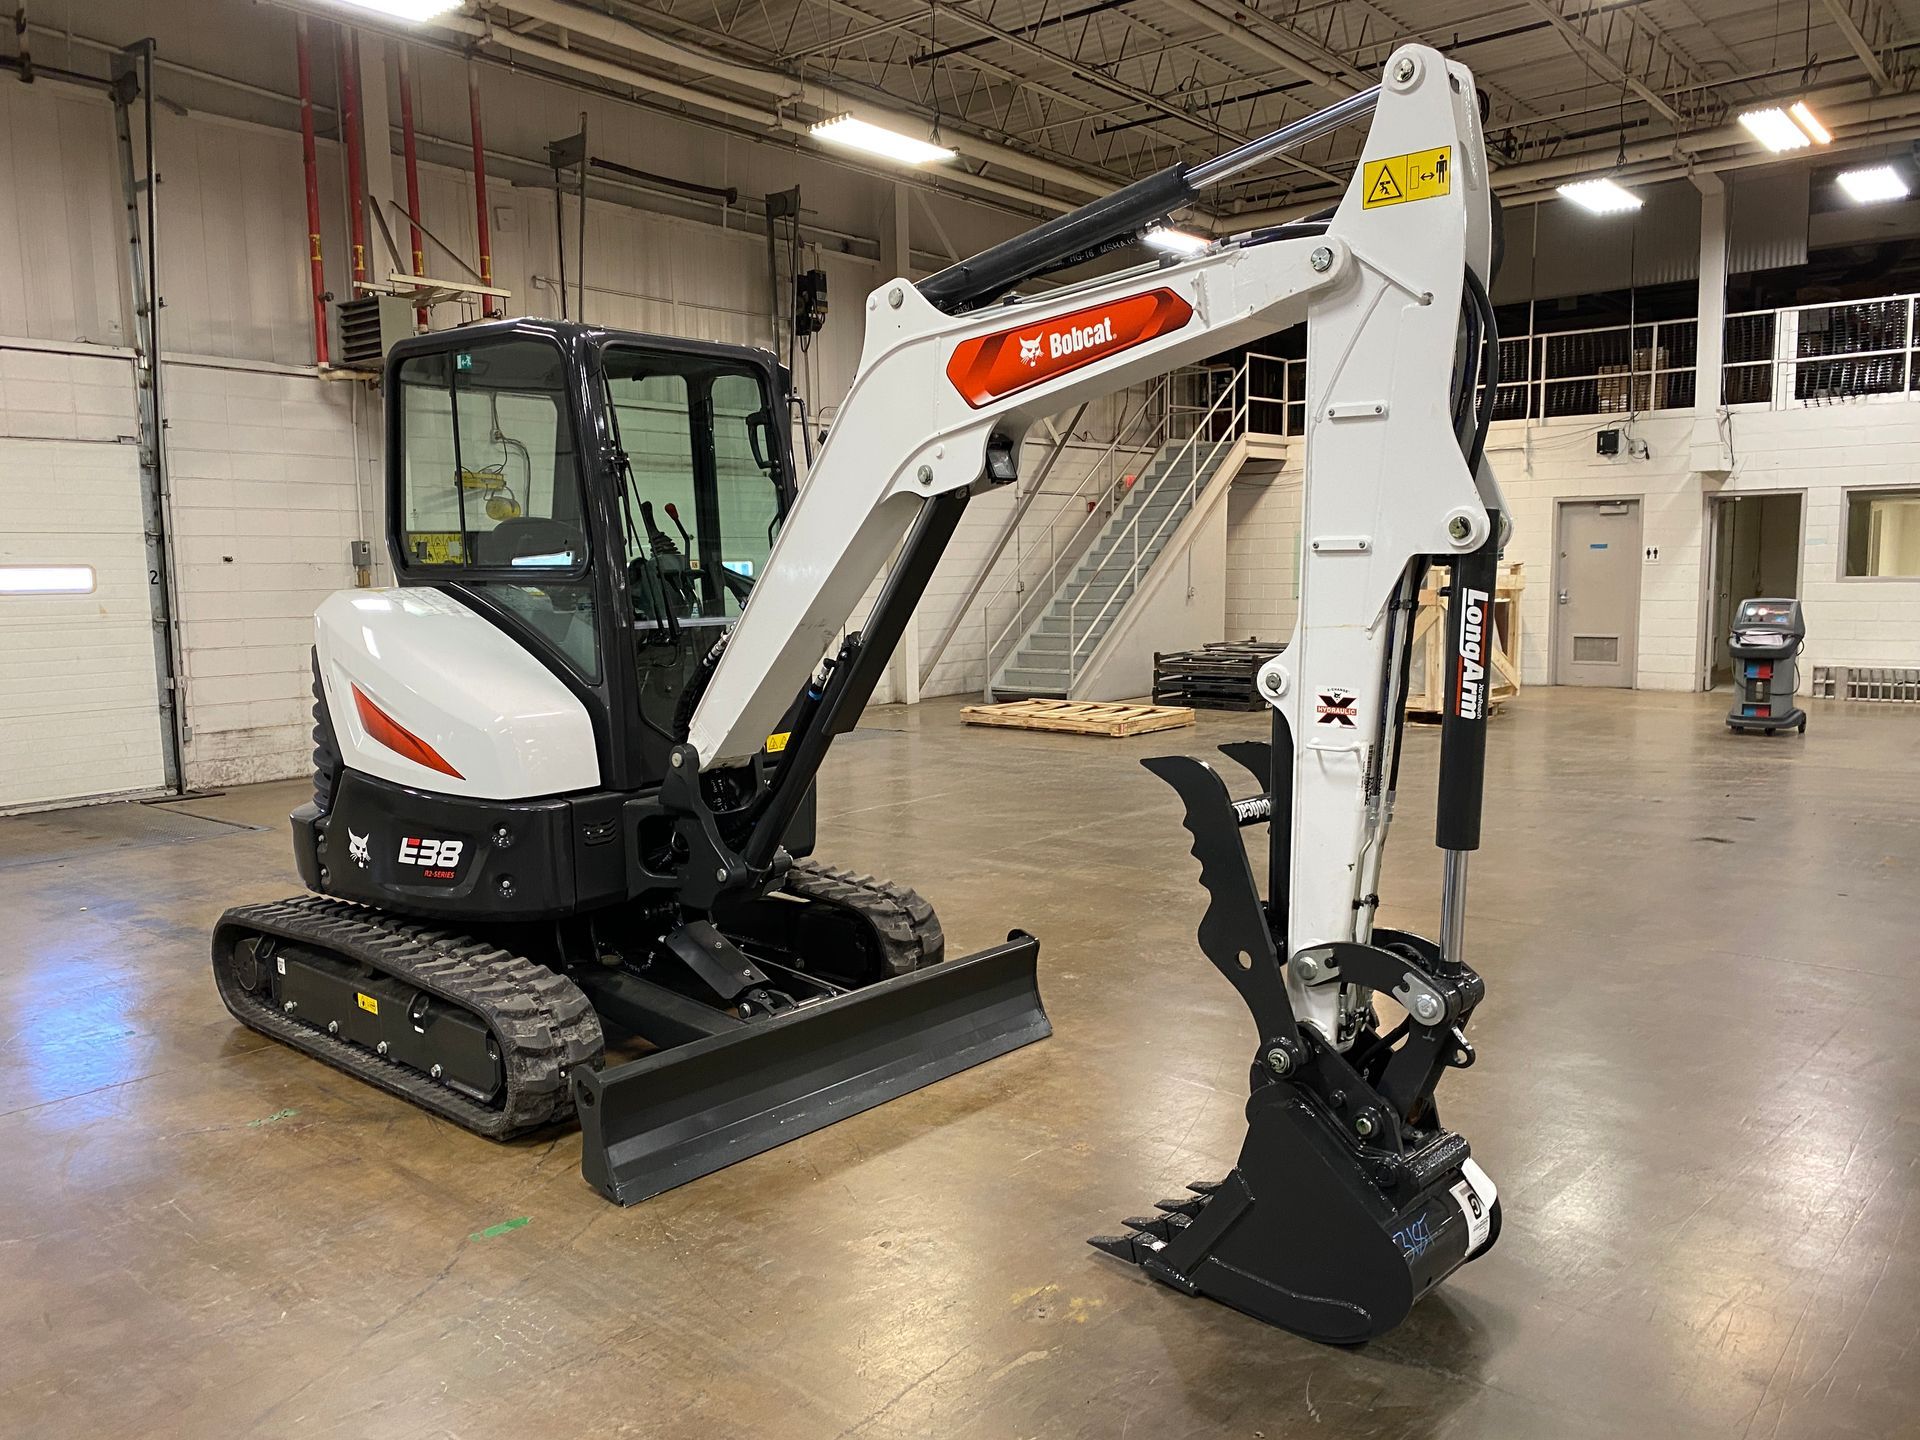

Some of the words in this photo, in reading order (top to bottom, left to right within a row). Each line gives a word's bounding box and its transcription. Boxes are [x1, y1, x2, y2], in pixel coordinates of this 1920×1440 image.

[1049, 317, 1112, 359] Bobcat
[150, 570, 159, 585] 2
[1460, 588, 1489, 720] LongArm
[1317, 706, 1357, 716] HYDRAULIC
[398, 837, 463, 868] E38
[424, 869, 455, 879] R2-SERIES
